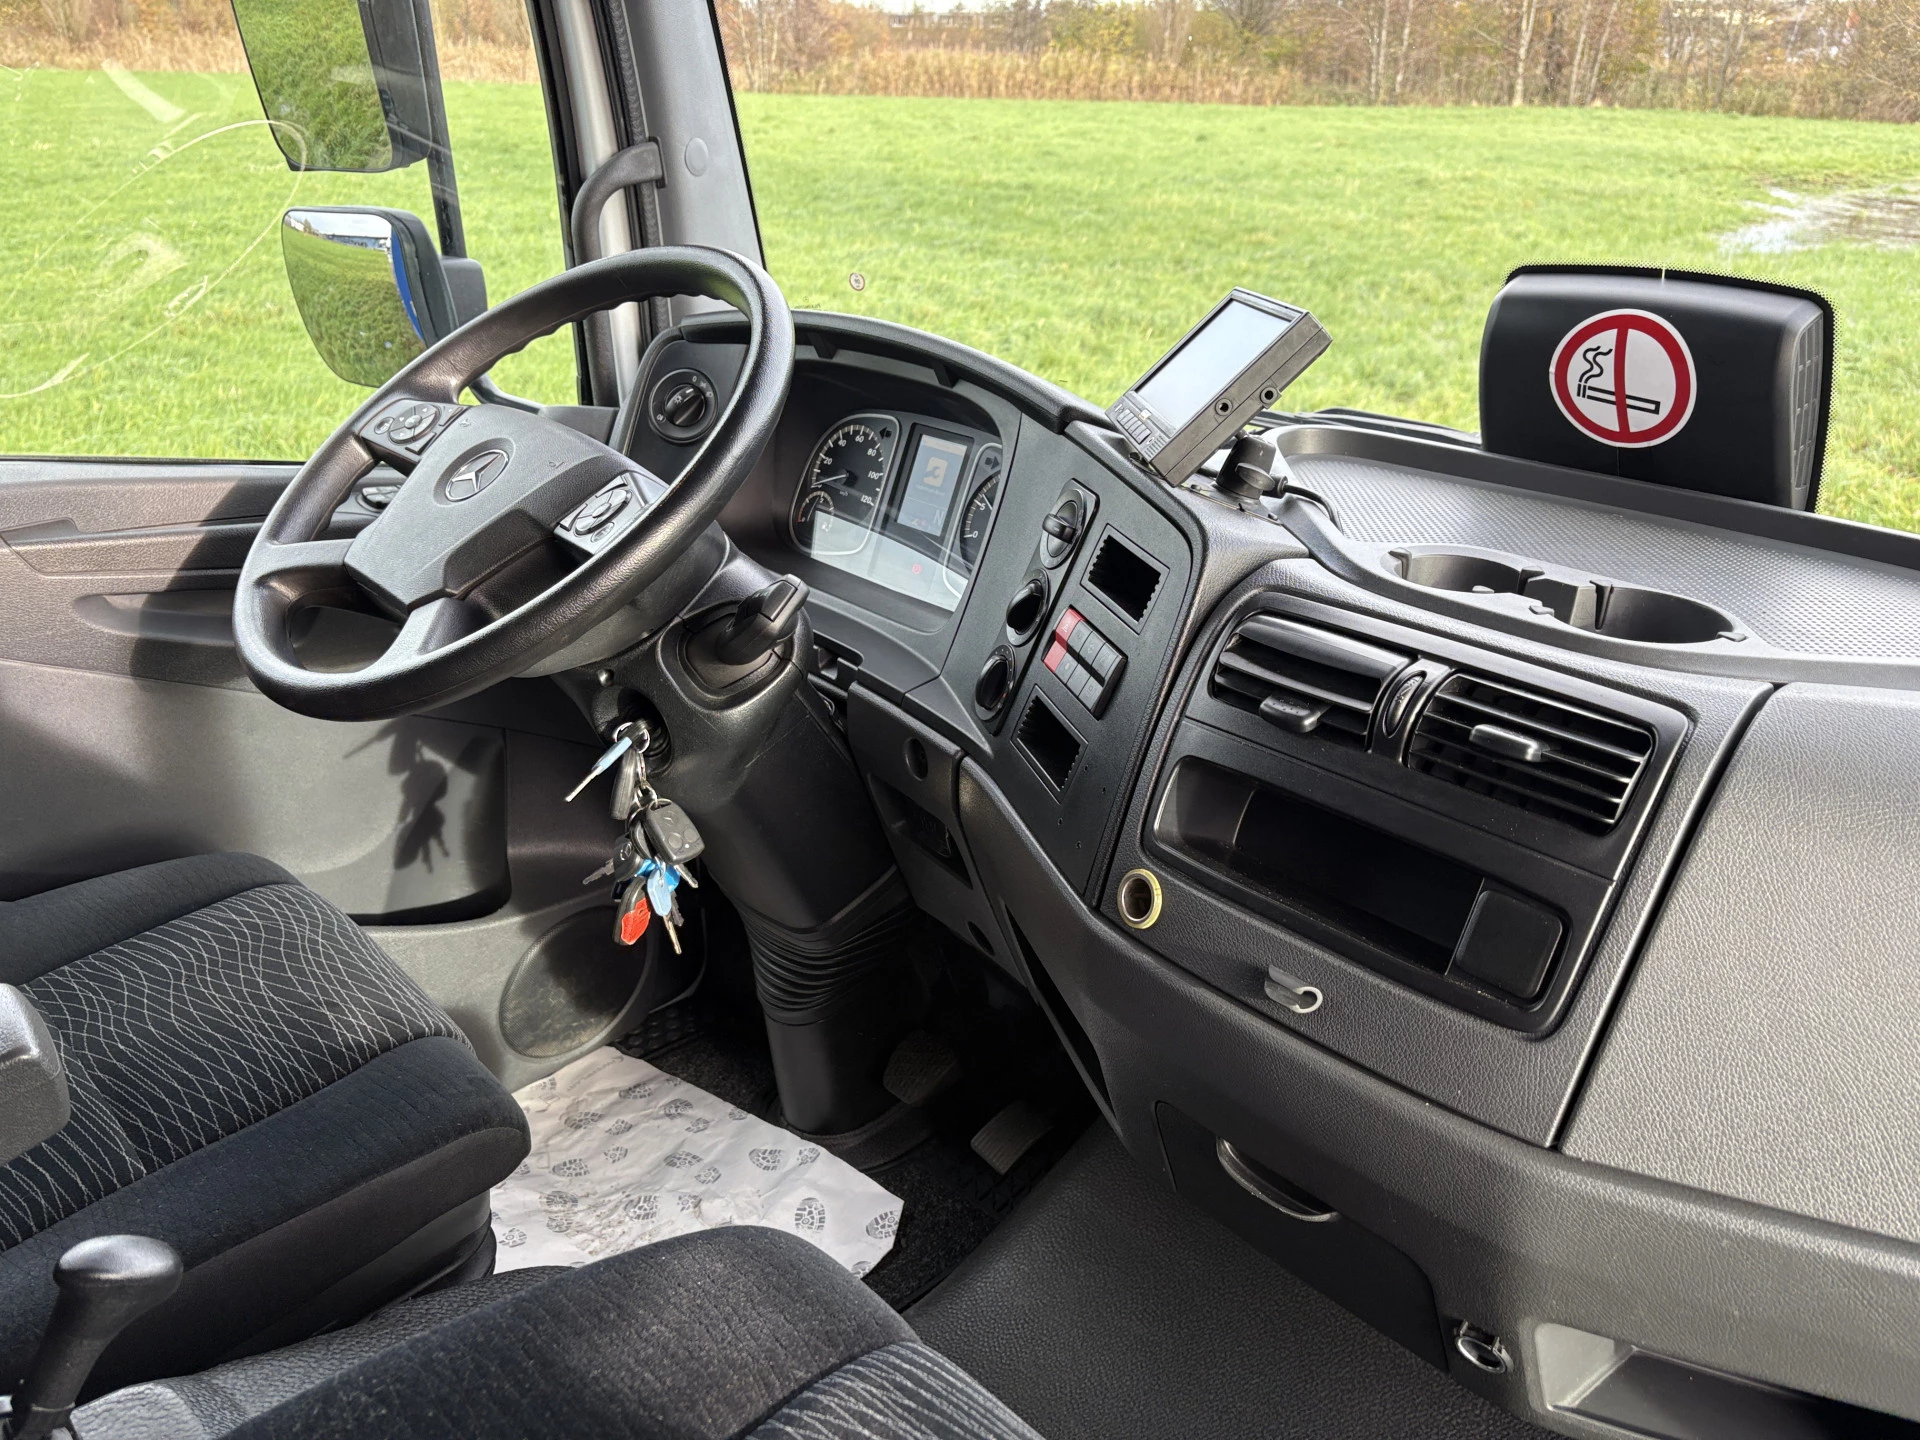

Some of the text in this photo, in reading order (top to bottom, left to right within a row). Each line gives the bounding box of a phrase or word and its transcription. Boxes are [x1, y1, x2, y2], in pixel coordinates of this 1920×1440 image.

[855, 435, 865, 443] 60
[867, 448, 877, 457] 80
[823, 457, 833, 465] 20
[868, 471, 879, 480] 100
[860, 494, 873, 504] 120
